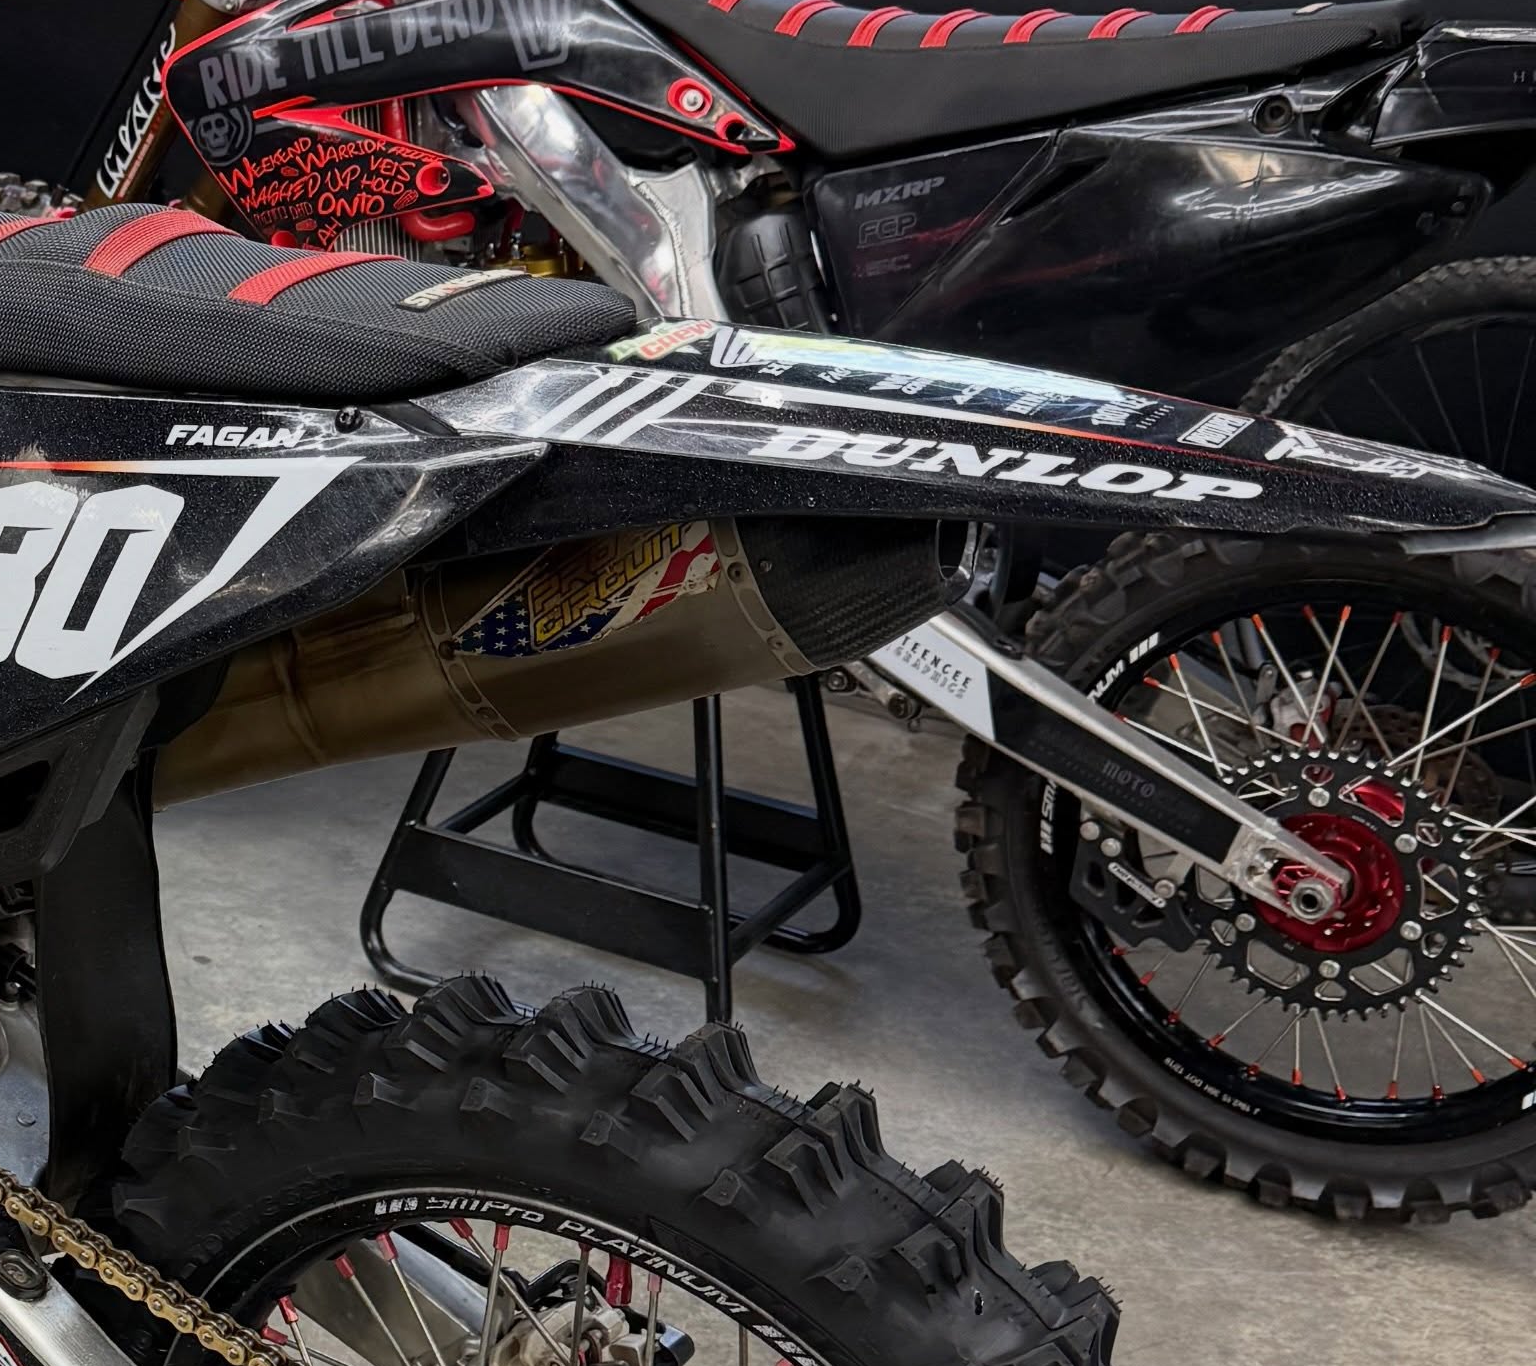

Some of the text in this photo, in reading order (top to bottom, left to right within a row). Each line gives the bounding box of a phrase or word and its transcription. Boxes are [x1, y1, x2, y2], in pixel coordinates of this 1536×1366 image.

[199, 41, 287, 110] RIDE
[292, 12, 384, 81] TILL
[219, 137, 312, 195] WEEKEND
[295, 138, 387, 174] WARRIOR
[324, 164, 361, 193] UP
[854, 176, 946, 210] MXRP
[317, 192, 385, 217] ONTO
[165, 424, 305, 449] FAGAN
[749, 425, 1264, 502] DUNLOP
[533, 523, 683, 645] CIRCUIT
[556, 1219, 751, 1314] PLATINUM
